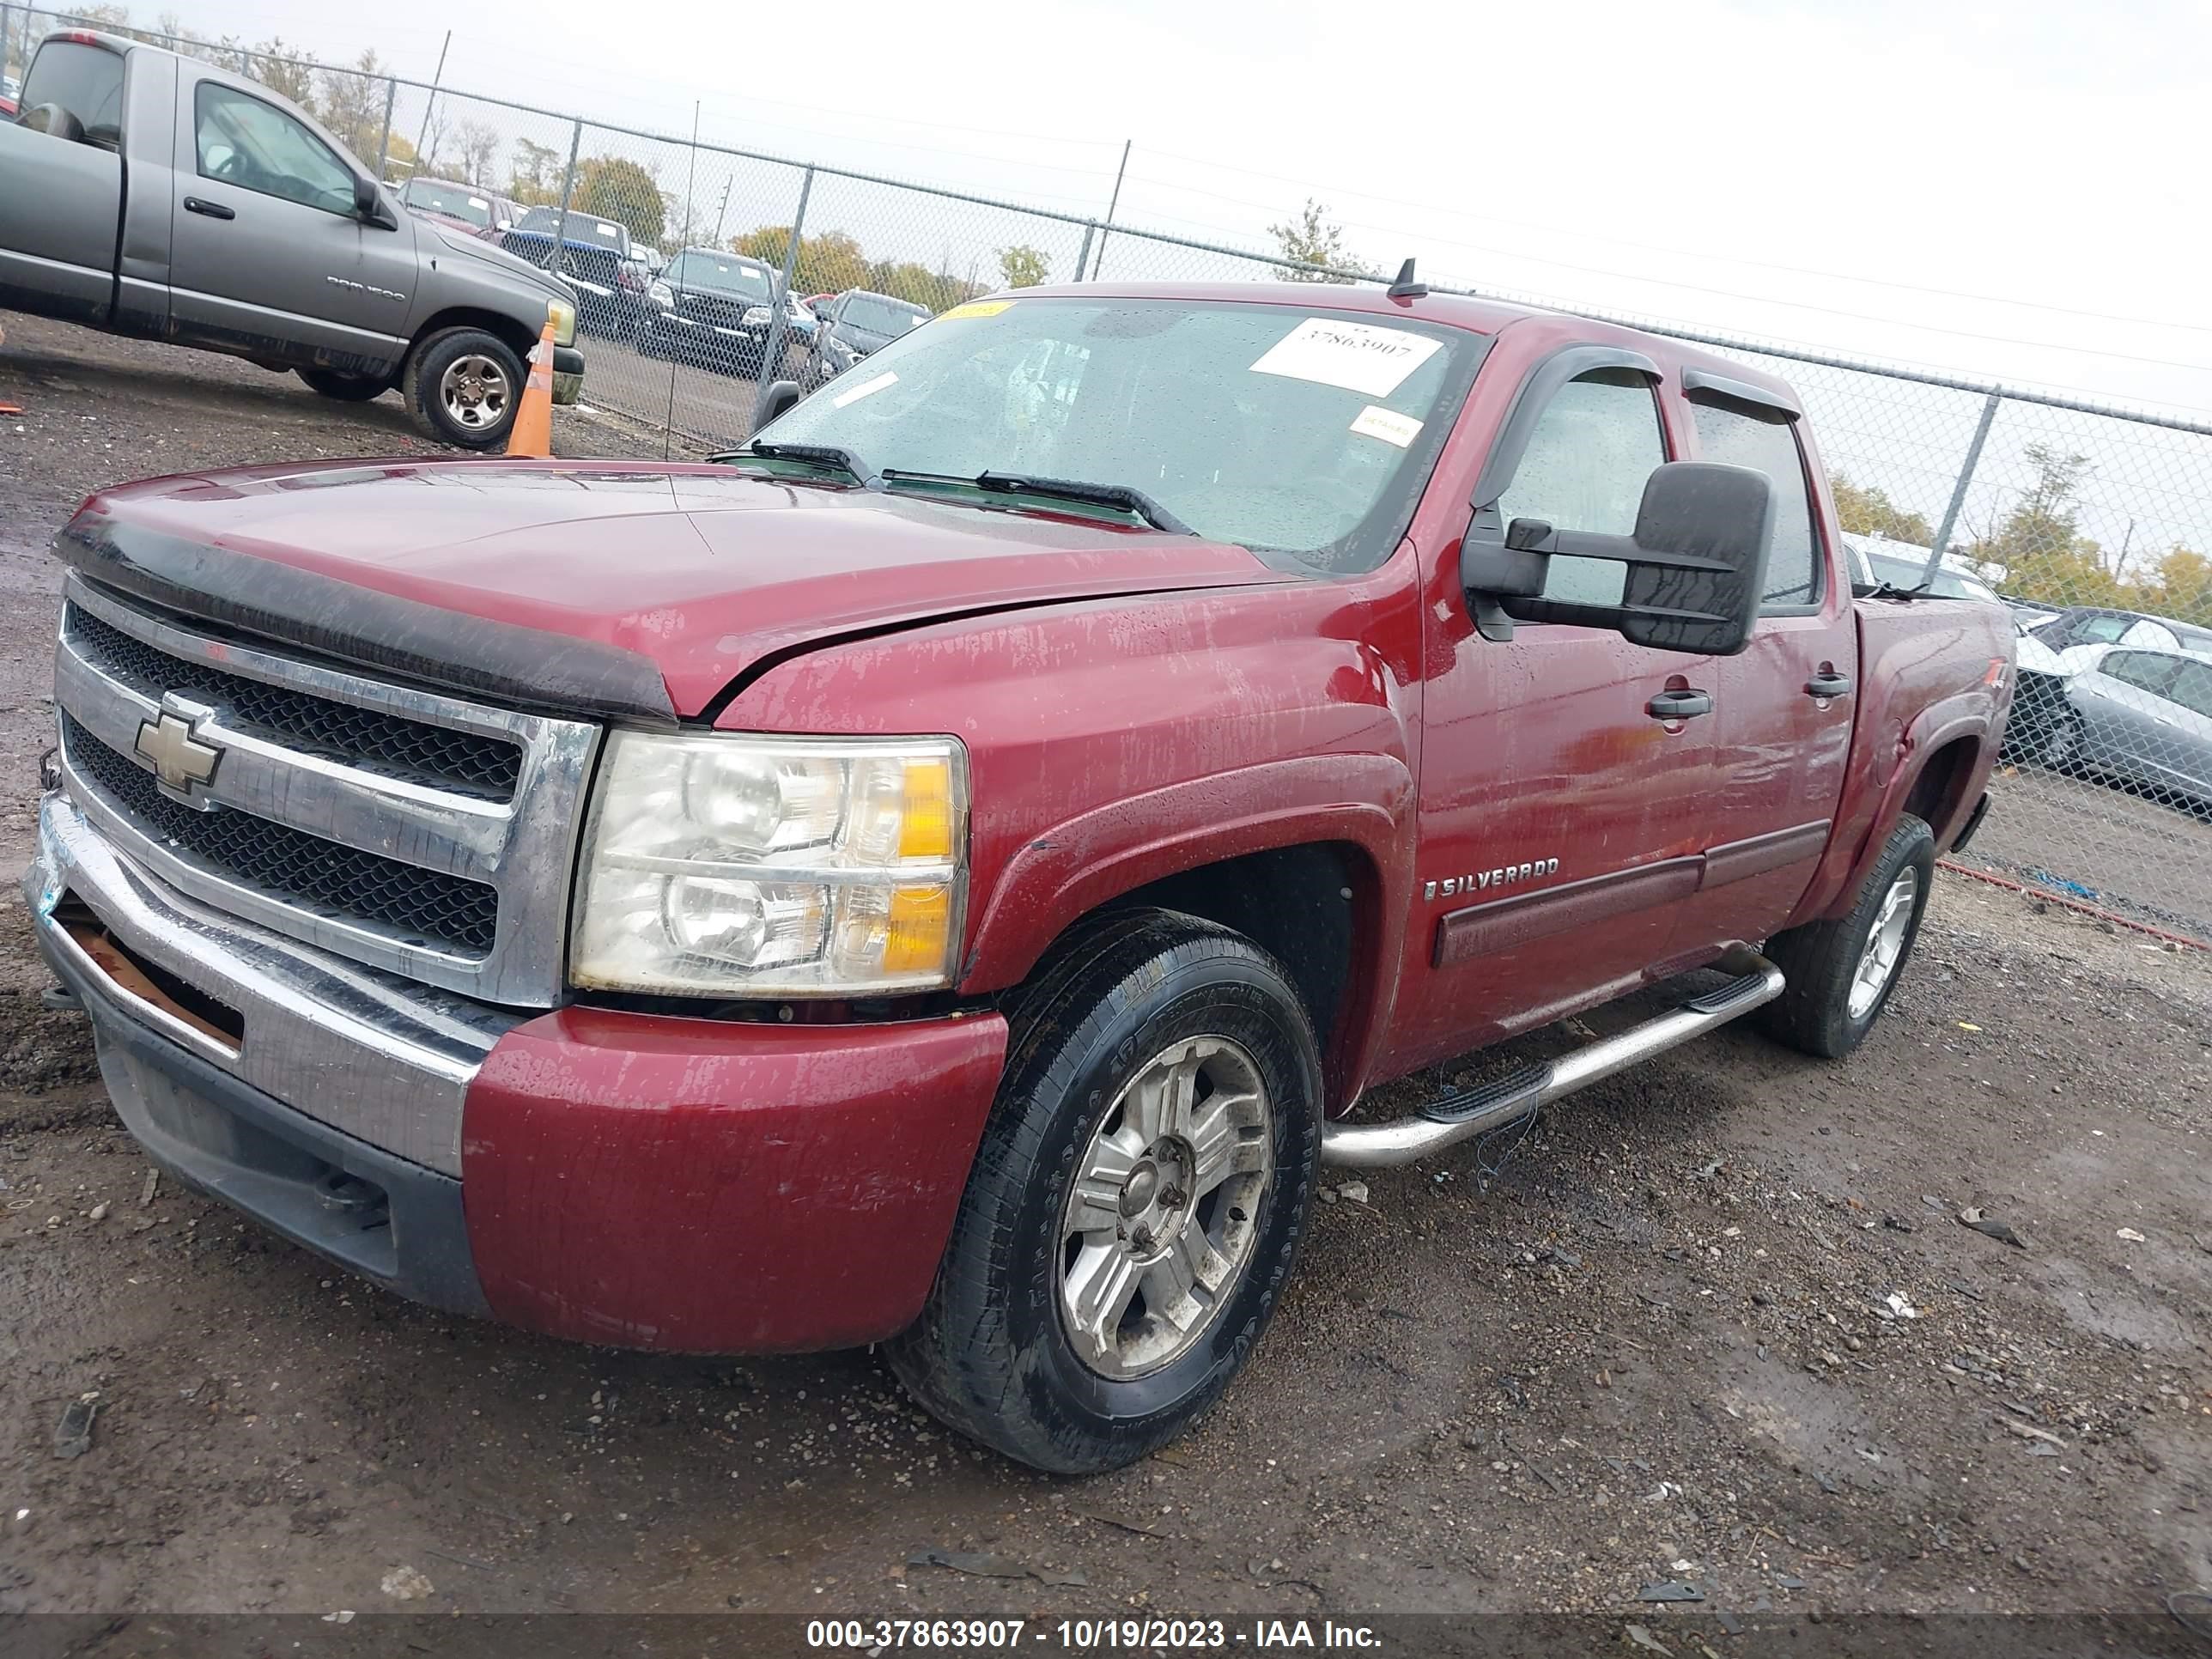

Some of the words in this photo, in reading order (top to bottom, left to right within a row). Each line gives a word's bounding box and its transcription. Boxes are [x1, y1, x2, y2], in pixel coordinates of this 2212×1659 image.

[366, 284, 406, 302] 1500
[1301, 329, 1413, 358] 37863907
[1439, 857, 1559, 896] SILVERADO
